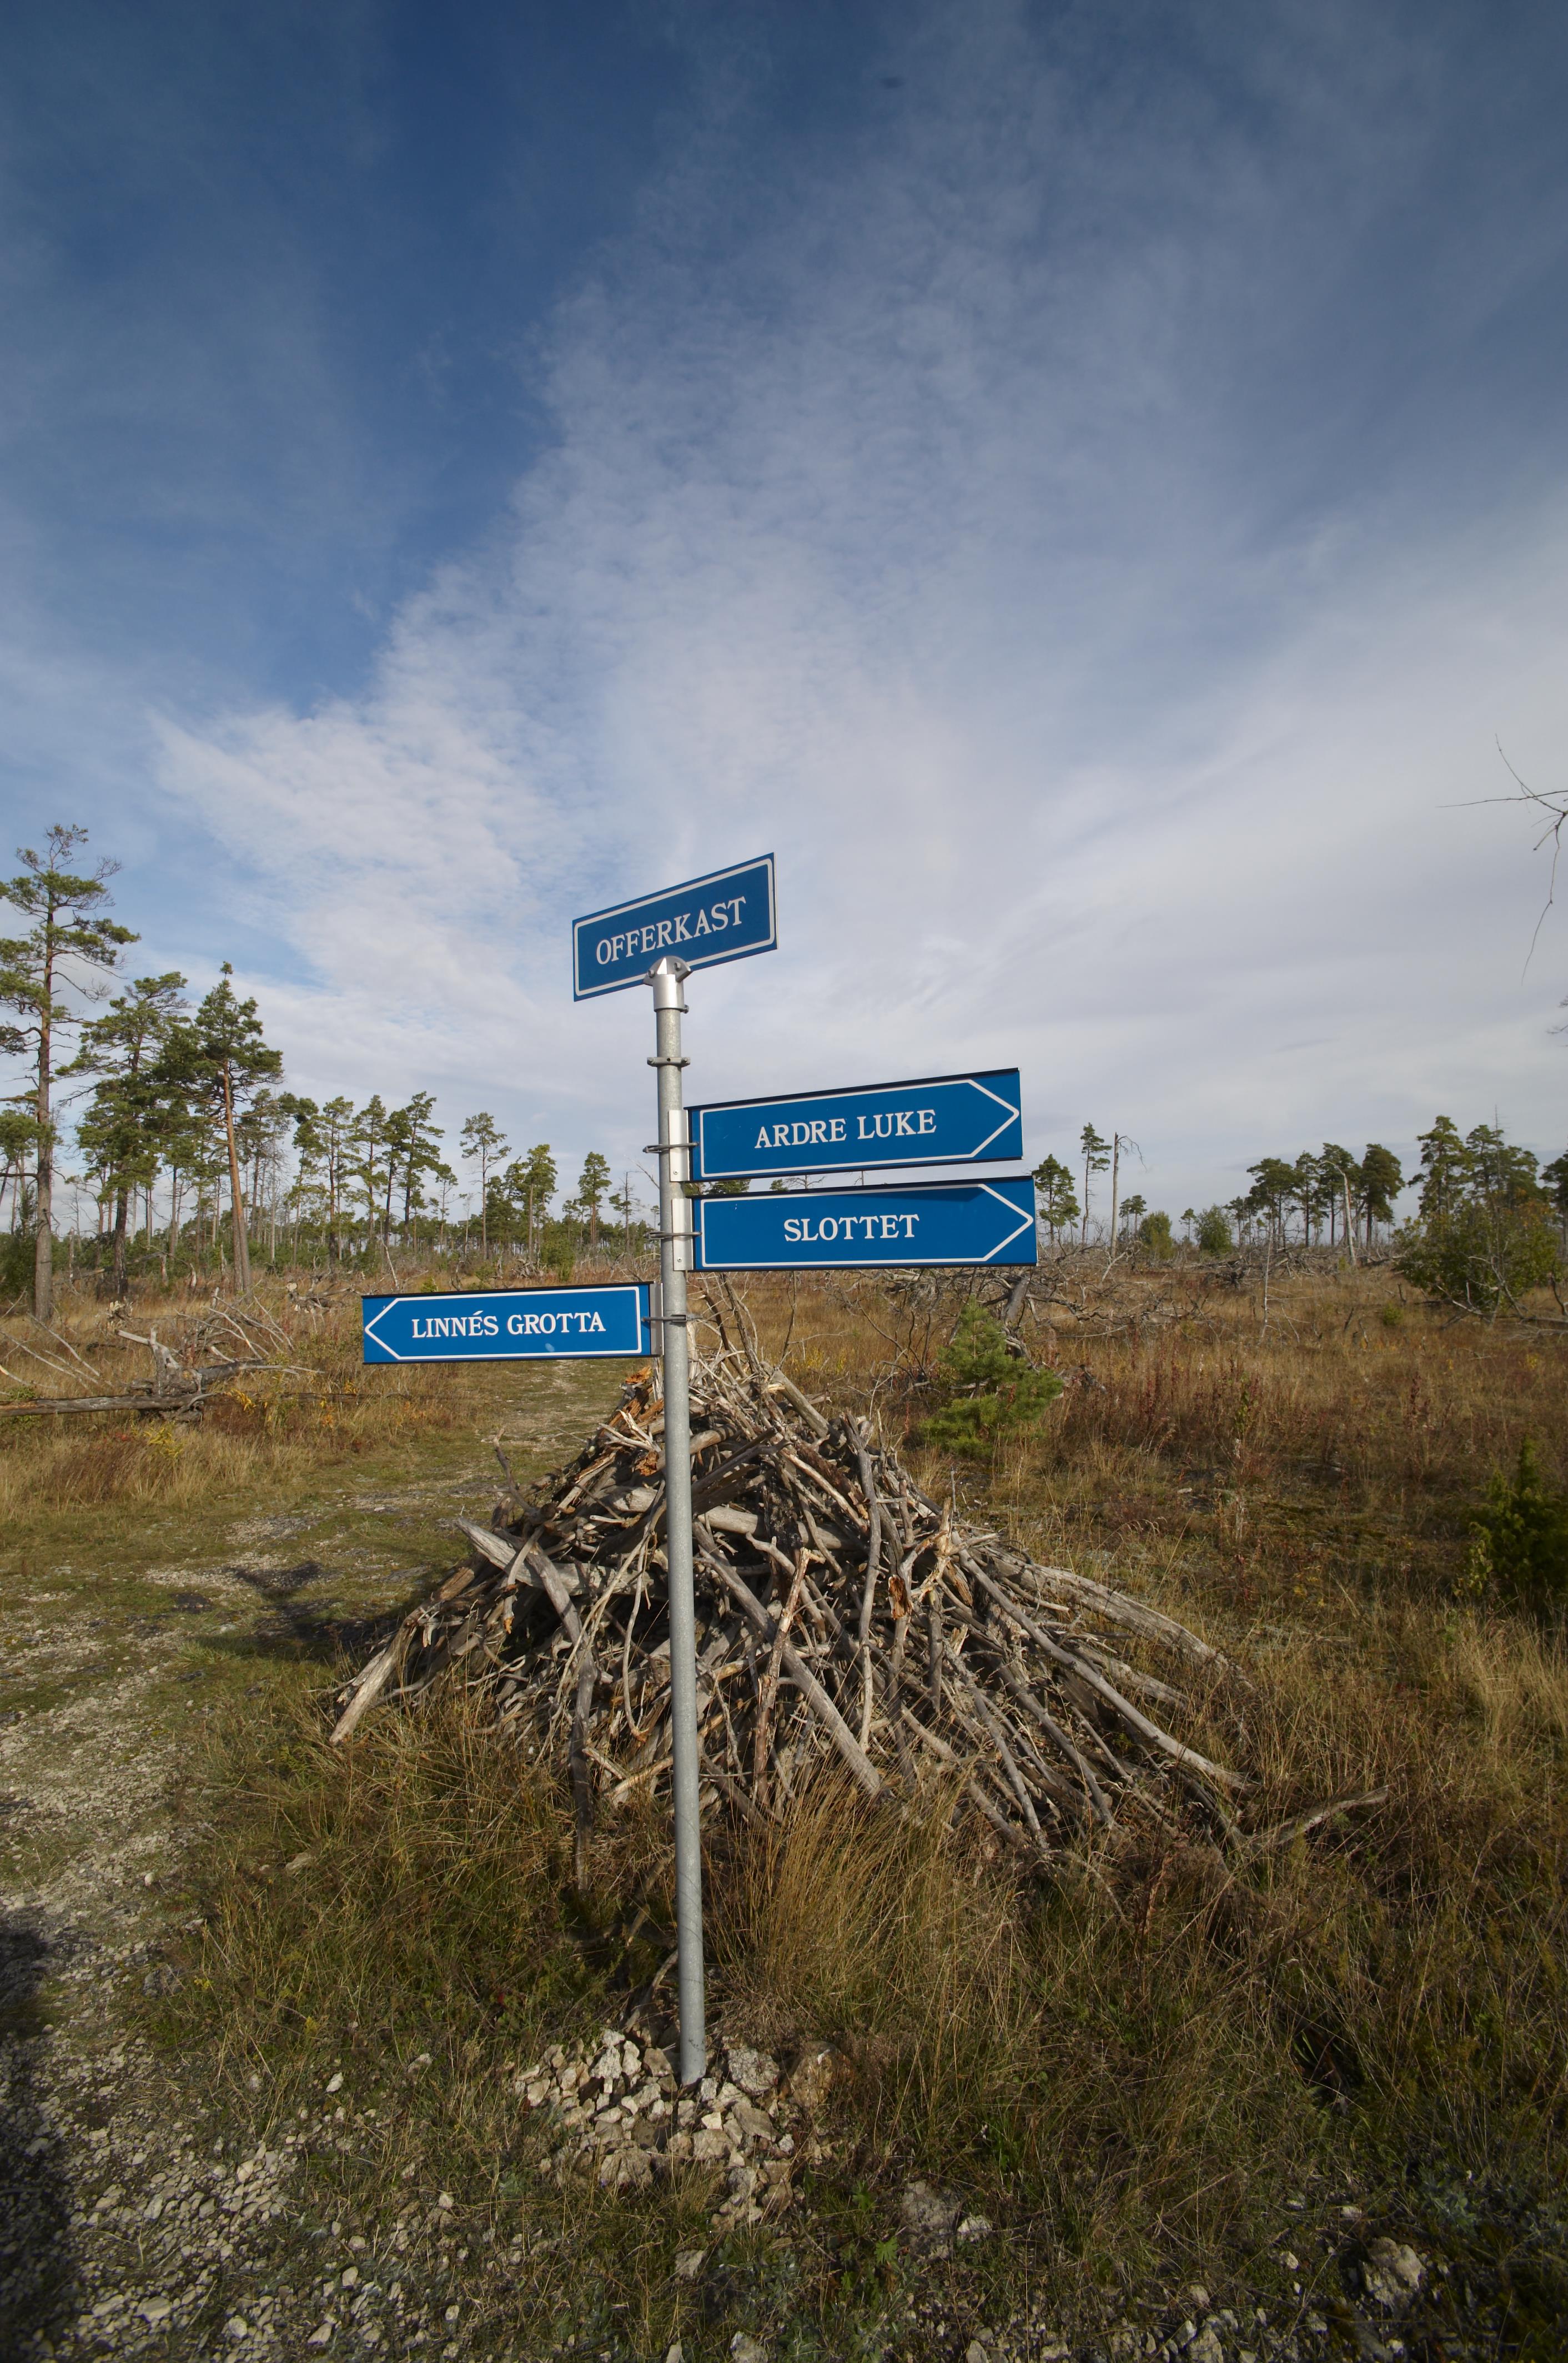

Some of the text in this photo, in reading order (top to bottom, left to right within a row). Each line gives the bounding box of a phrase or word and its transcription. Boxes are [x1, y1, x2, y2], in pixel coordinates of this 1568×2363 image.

[596, 896, 746, 964] OFFERKAST
[755, 1109, 937, 1149] ARDRE LUKE
[783, 1214, 919, 1241] SLOTTET
[411, 1310, 606, 1338] LINNÉS GROTTA
